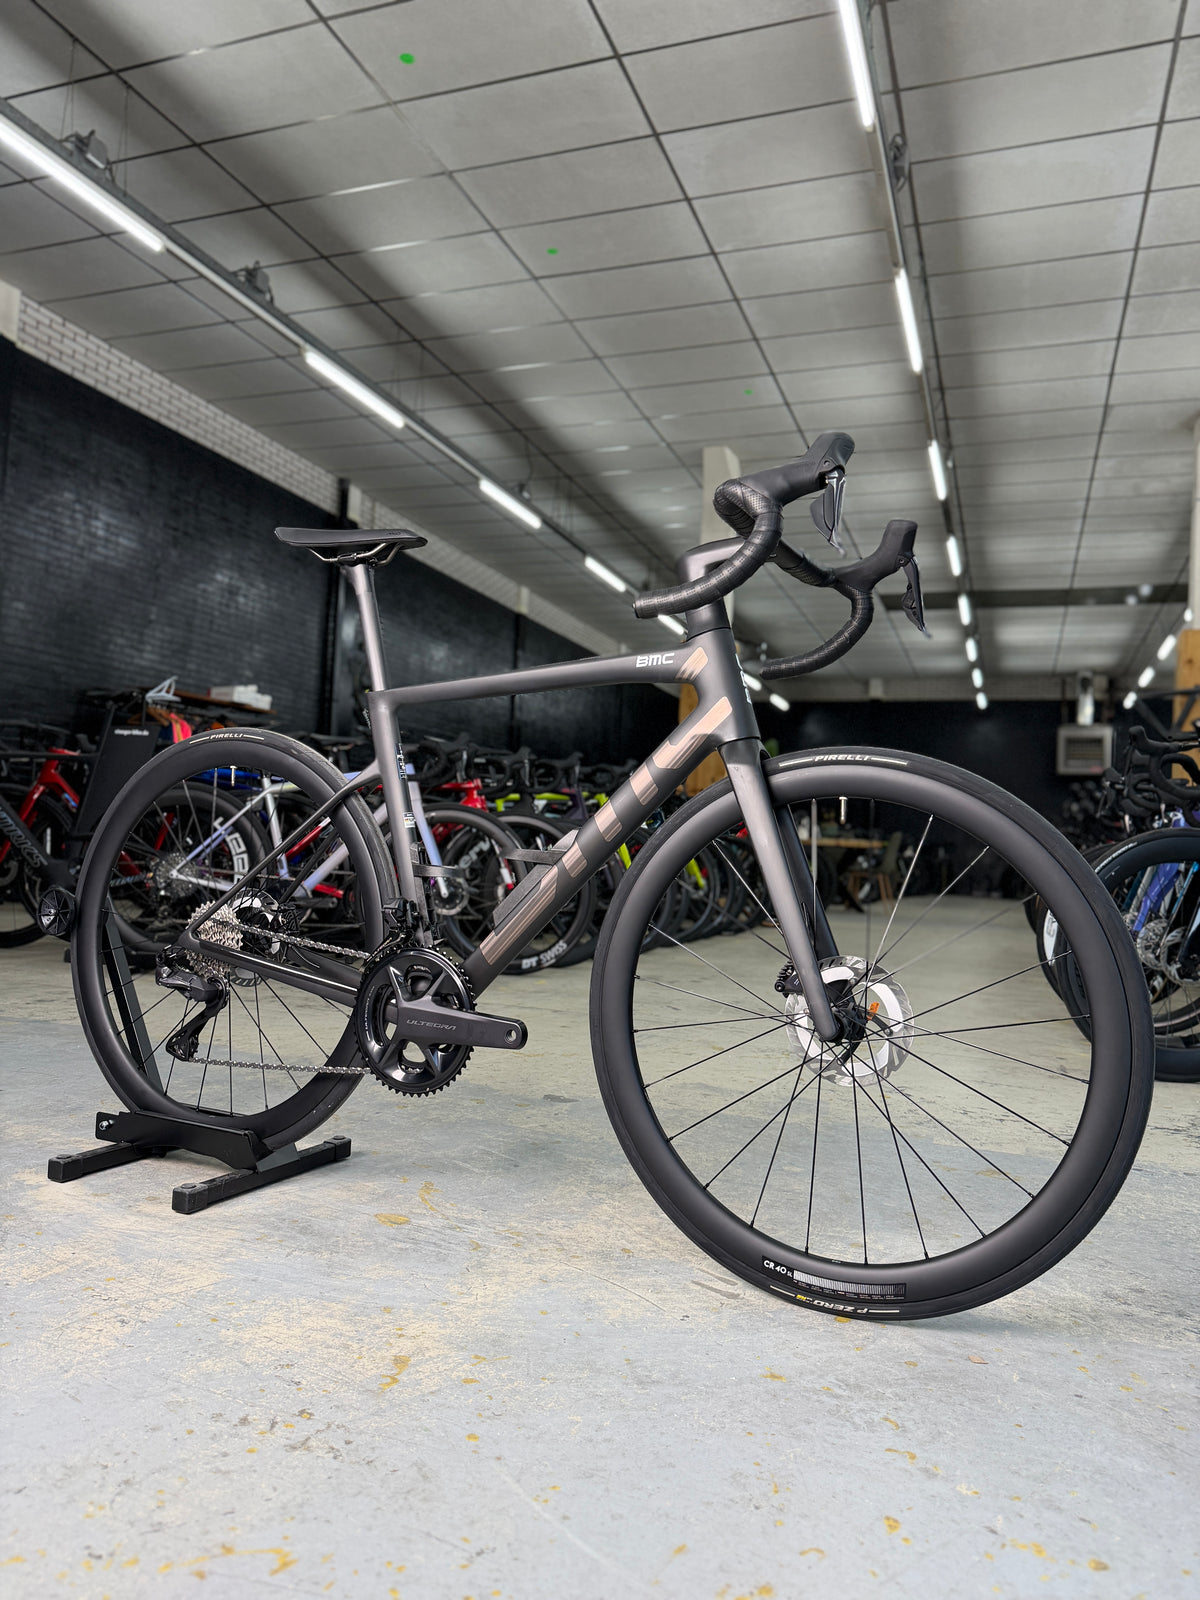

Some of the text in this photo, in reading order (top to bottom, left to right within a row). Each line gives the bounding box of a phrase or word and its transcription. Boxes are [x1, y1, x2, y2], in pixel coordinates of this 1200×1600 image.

[636, 653, 675, 667] BMC
[814, 754, 870, 762] PIRELLI
[521, 939, 568, 969] DT SWISS
[406, 1018, 457, 1031] ULTEGRA
[764, 1260, 775, 1270] CR
[775, 1265, 787, 1274] 40
[813, 1300, 855, 1313] ZERO
